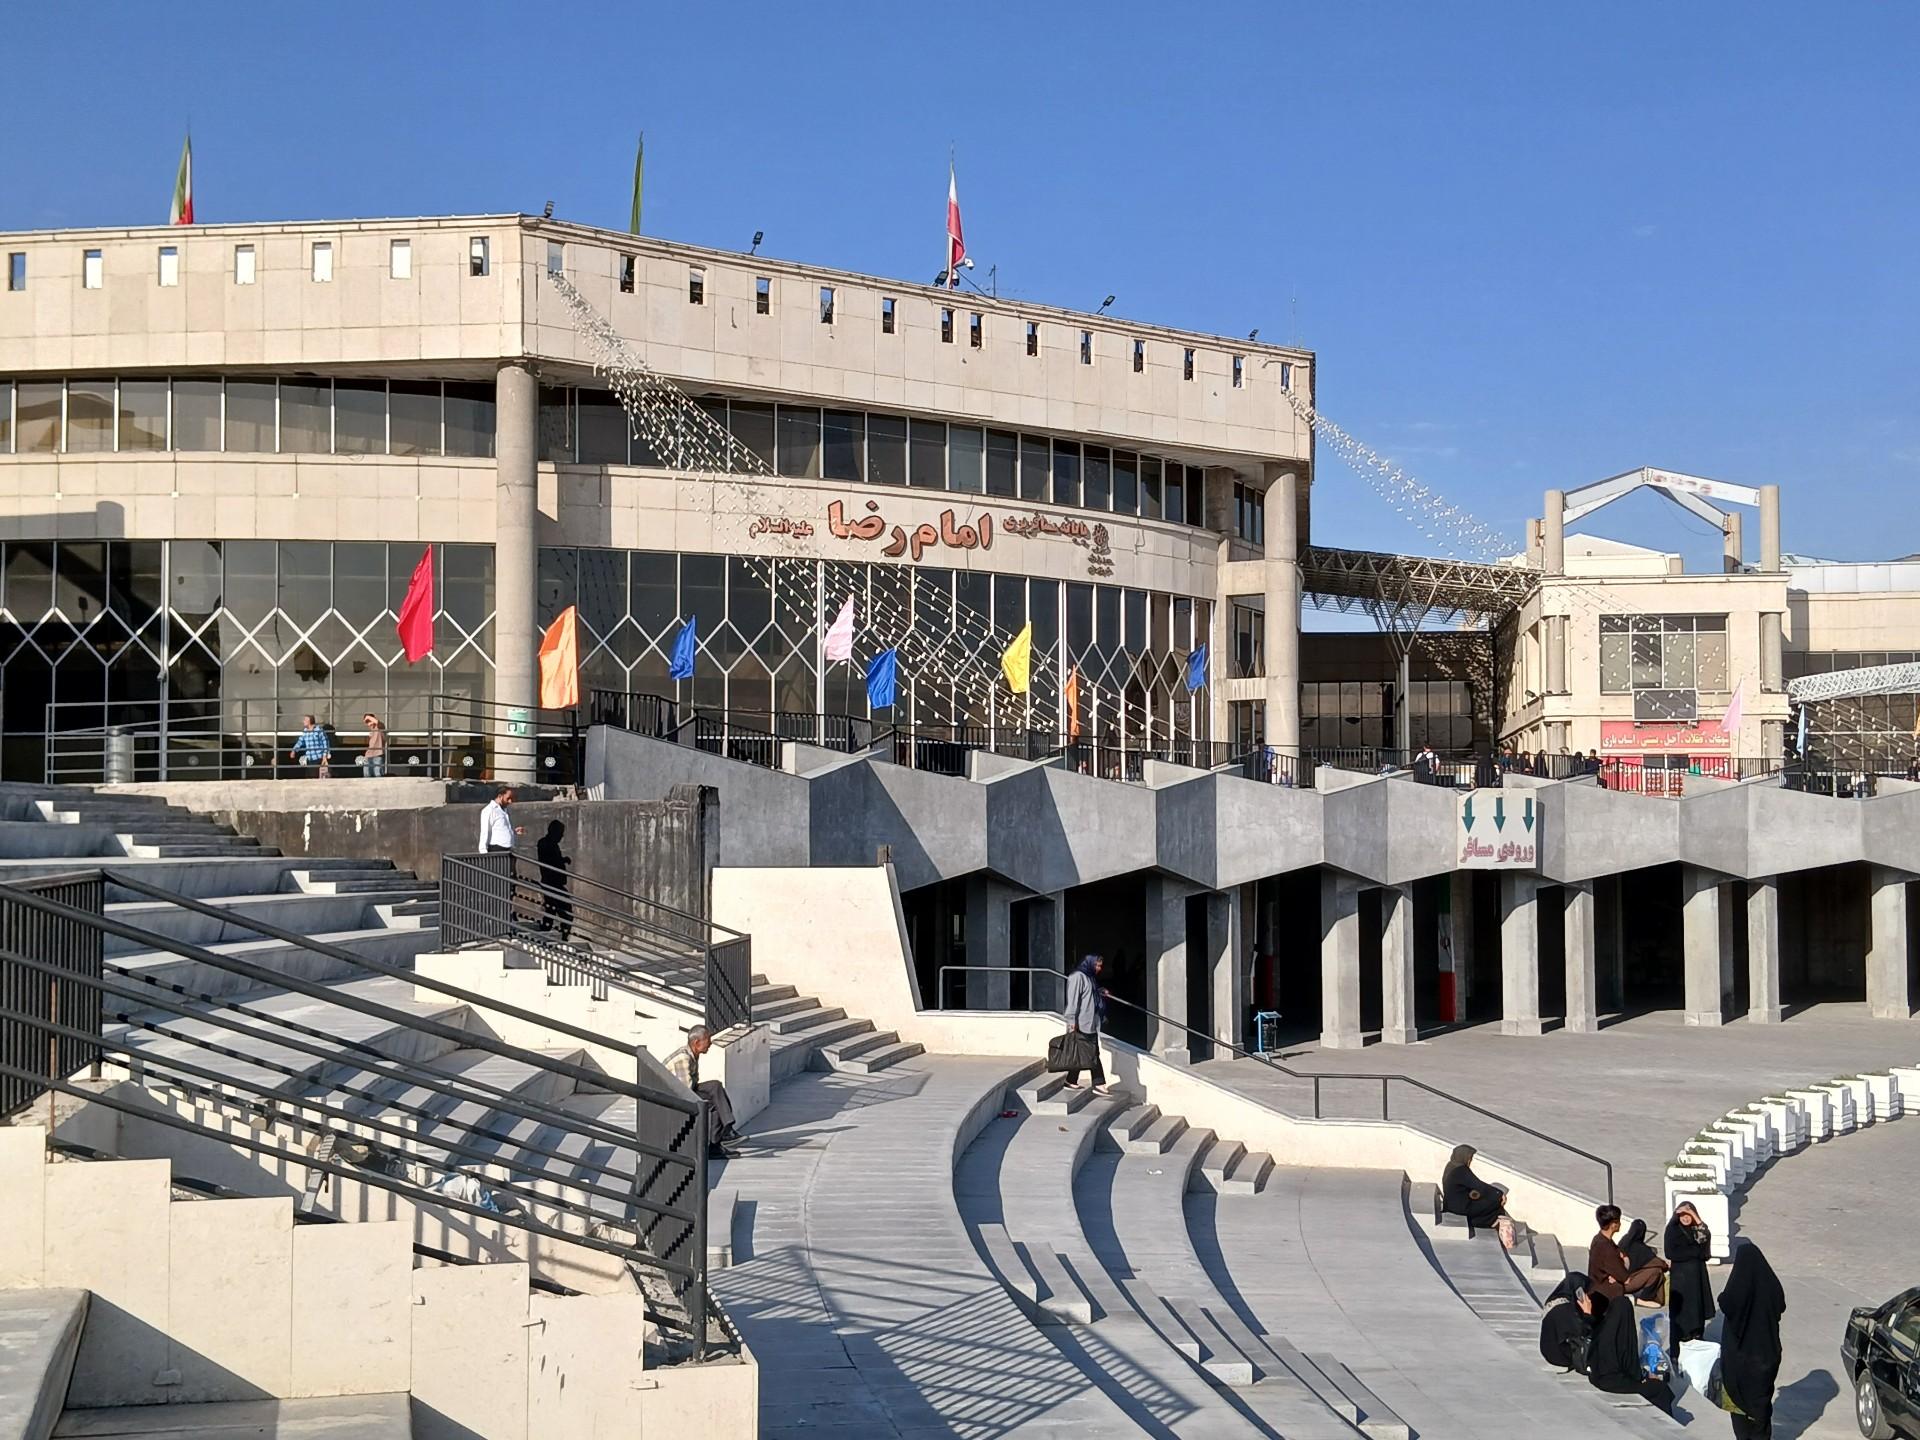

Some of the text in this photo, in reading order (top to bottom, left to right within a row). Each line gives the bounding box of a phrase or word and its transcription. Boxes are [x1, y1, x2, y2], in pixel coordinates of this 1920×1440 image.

[828, 499, 993, 562] امام رضا
[1460, 836, 1534, 863] ورودی مسافر
